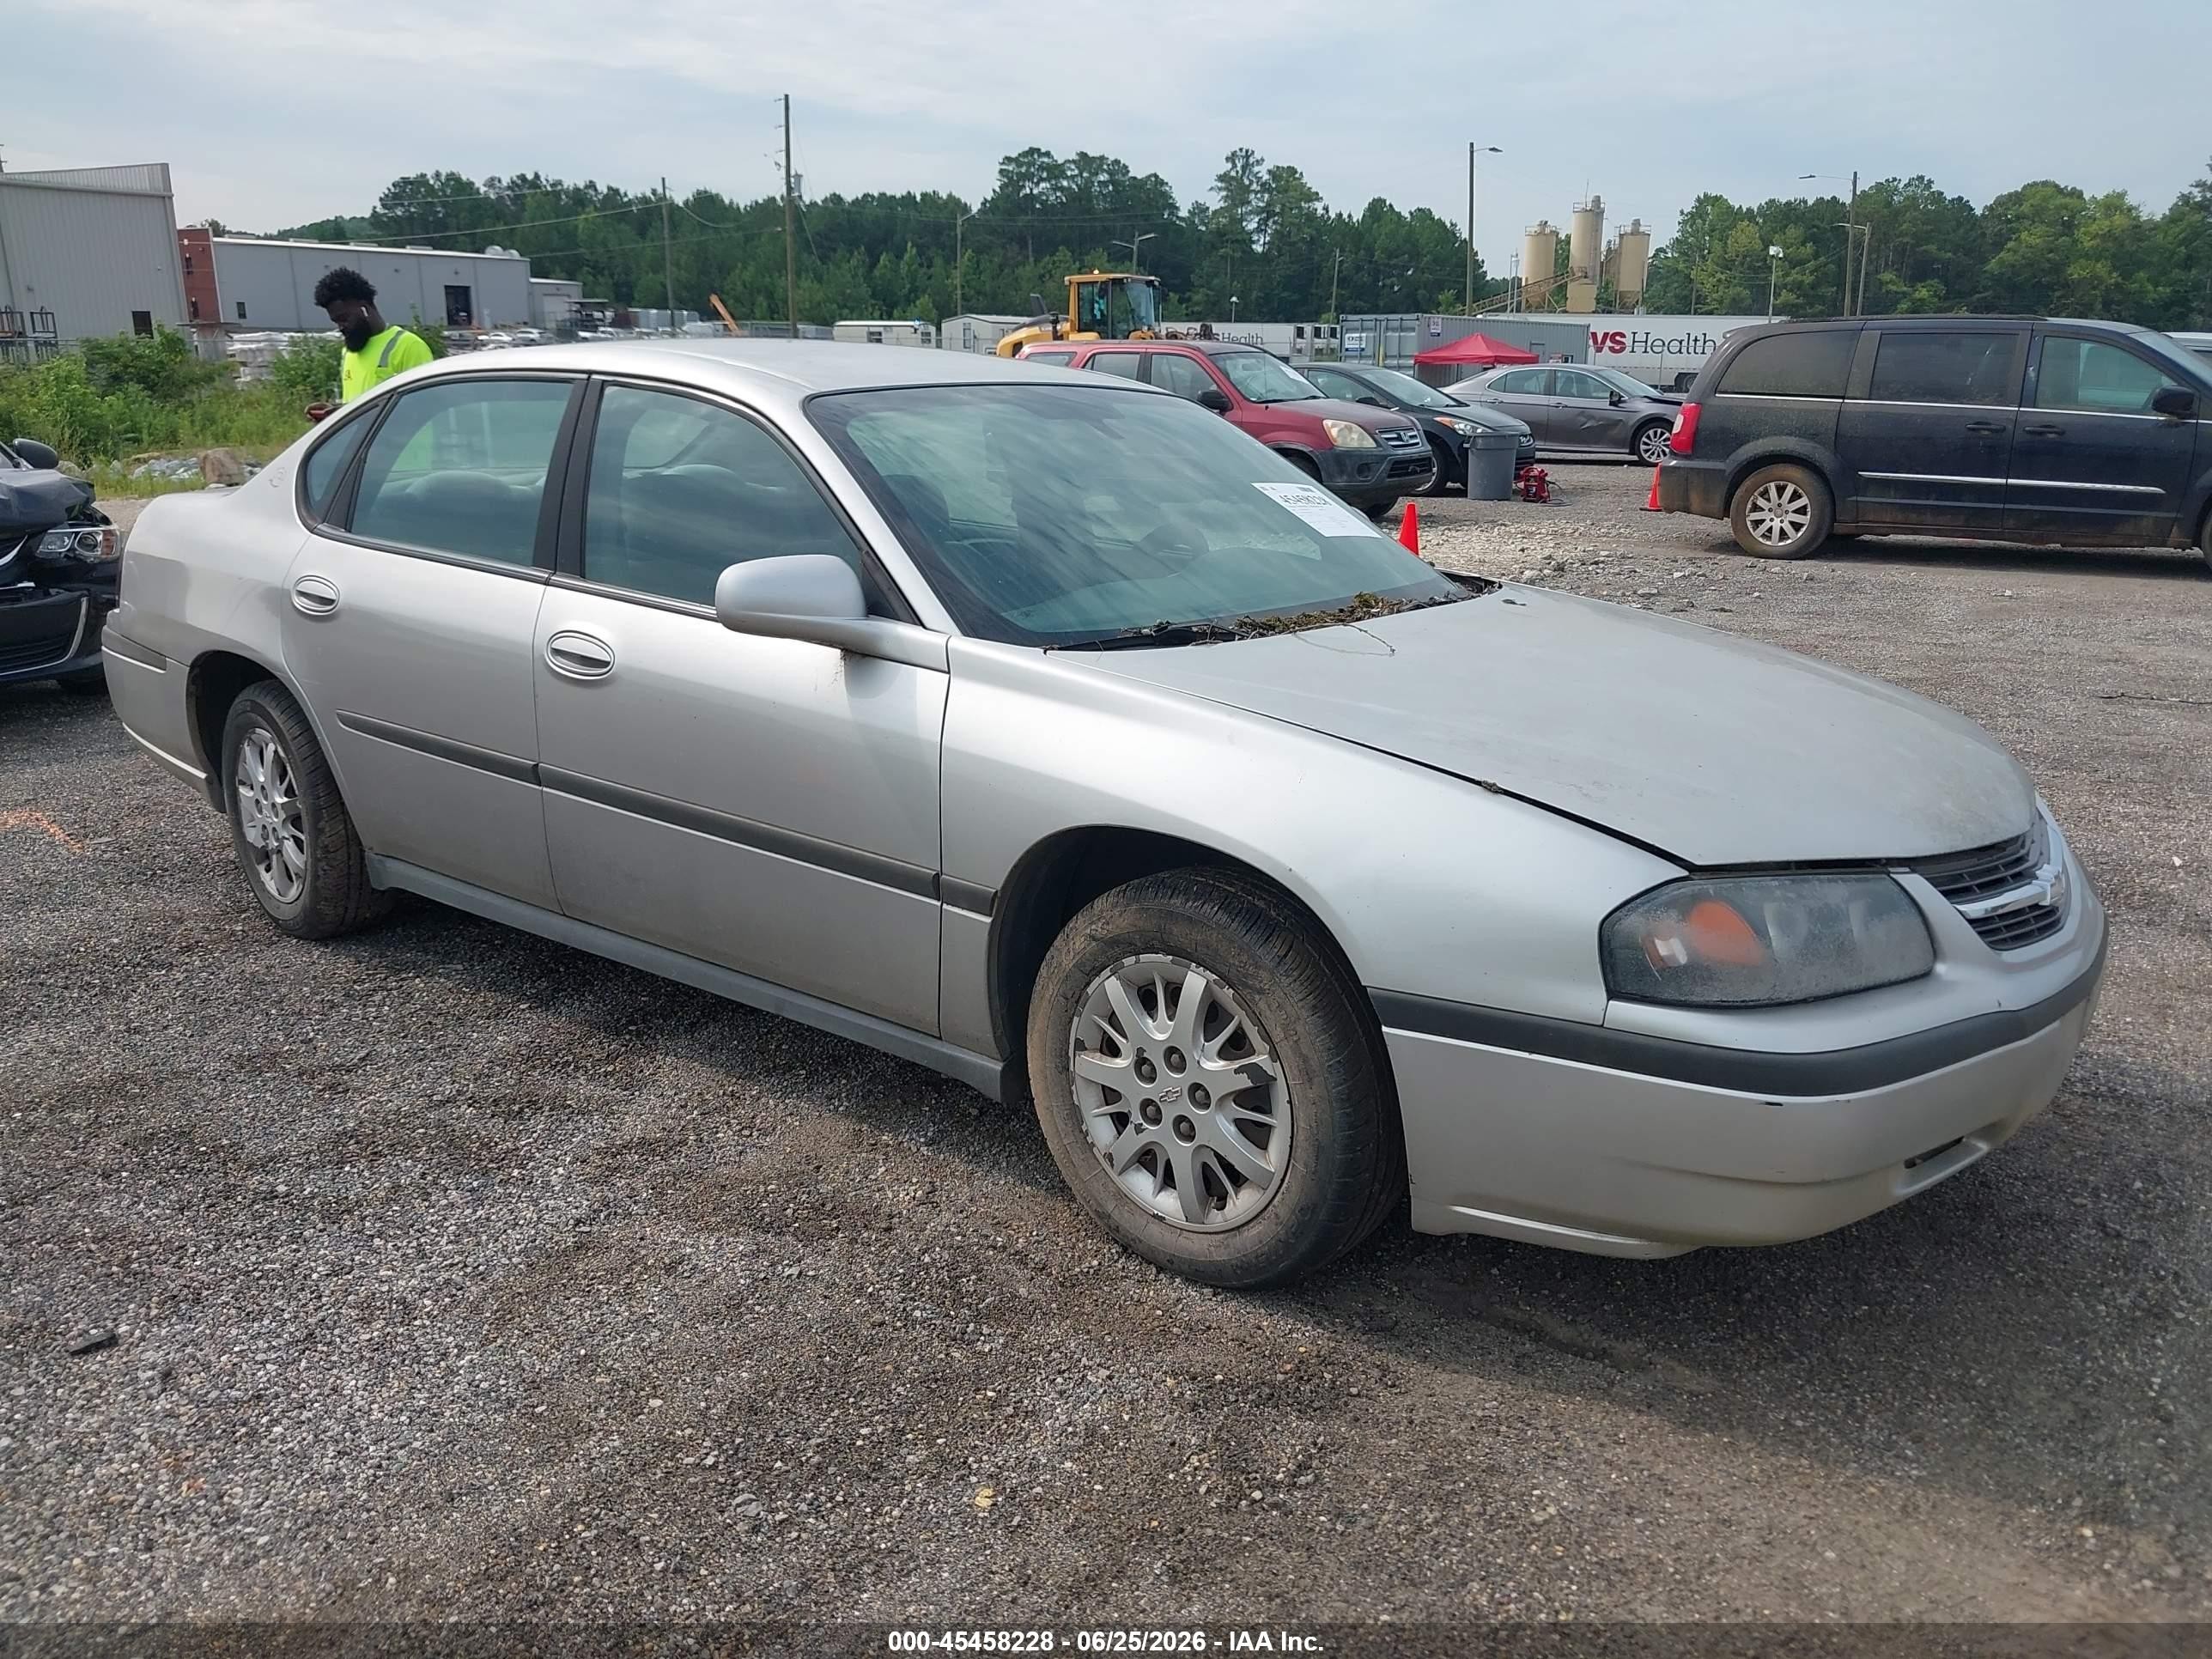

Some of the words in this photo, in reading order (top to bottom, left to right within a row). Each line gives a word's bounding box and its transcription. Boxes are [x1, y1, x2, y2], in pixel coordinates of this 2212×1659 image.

[1222, 332, 1263, 345] Health
[1589, 331, 1627, 355] VS
[1629, 331, 1717, 356] Health
